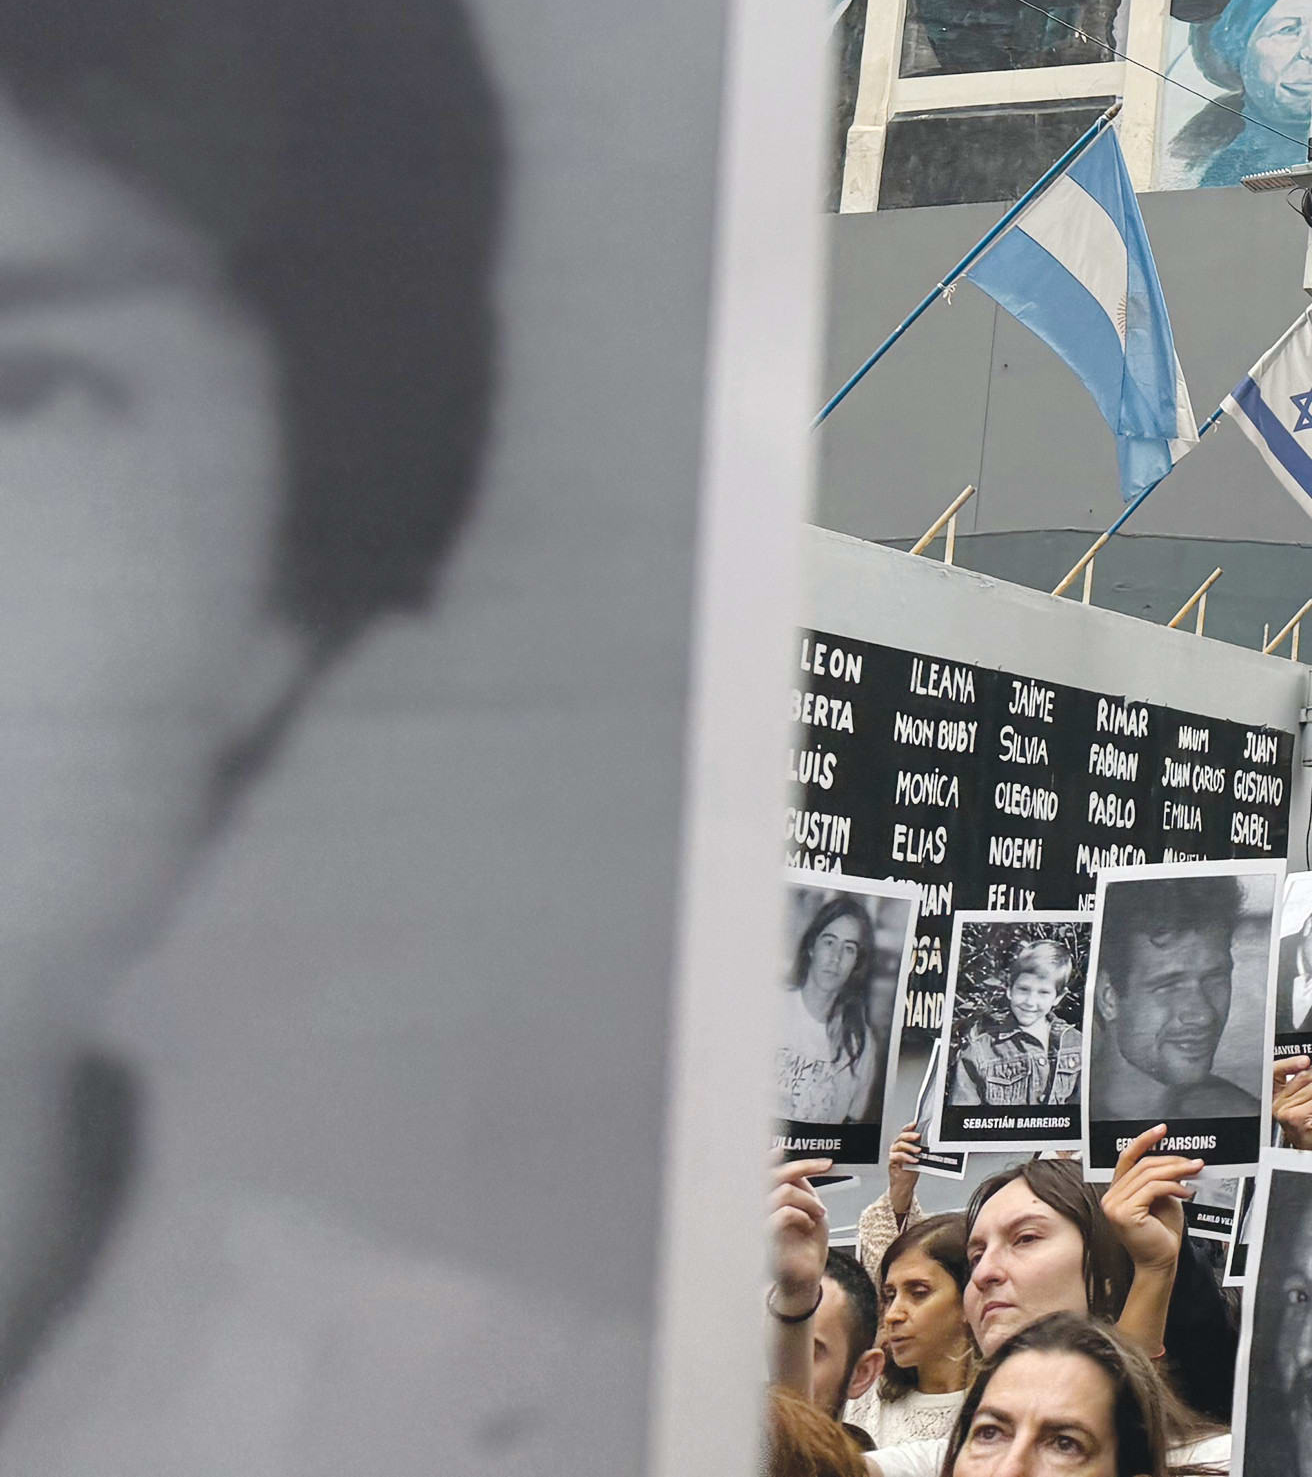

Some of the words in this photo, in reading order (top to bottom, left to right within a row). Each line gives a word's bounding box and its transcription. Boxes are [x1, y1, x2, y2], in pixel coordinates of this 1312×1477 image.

[800, 638, 863, 684] LEON
[910, 657, 976, 704] ILEANA
[937, 720, 978, 753] BUBY
[1096, 698, 1149, 738] RIMAR
[998, 725, 1049, 766] SILVIA
[1178, 726, 1209, 753] NAUM
[1243, 732, 1278, 765] JUAN
[1088, 742, 1139, 782] FABIAN
[1161, 757, 1191, 788] JUAN
[1192, 765, 1226, 794] CARLOS
[994, 782, 1059, 822] OLEGARIO
[1233, 769, 1284, 807] GUSTAVO
[1088, 791, 1136, 829] PABLO
[1162, 800, 1202, 833] EMILIA
[784, 807, 851, 855] GUSTIN
[891, 823, 948, 865] ELIAS
[1230, 811, 1272, 852] ISABEL
[962, 1115, 1015, 1129] SEBASTIÁN
[1017, 1116, 1071, 1129] BARREIROS
[1160, 1135, 1217, 1151] PARSONS
